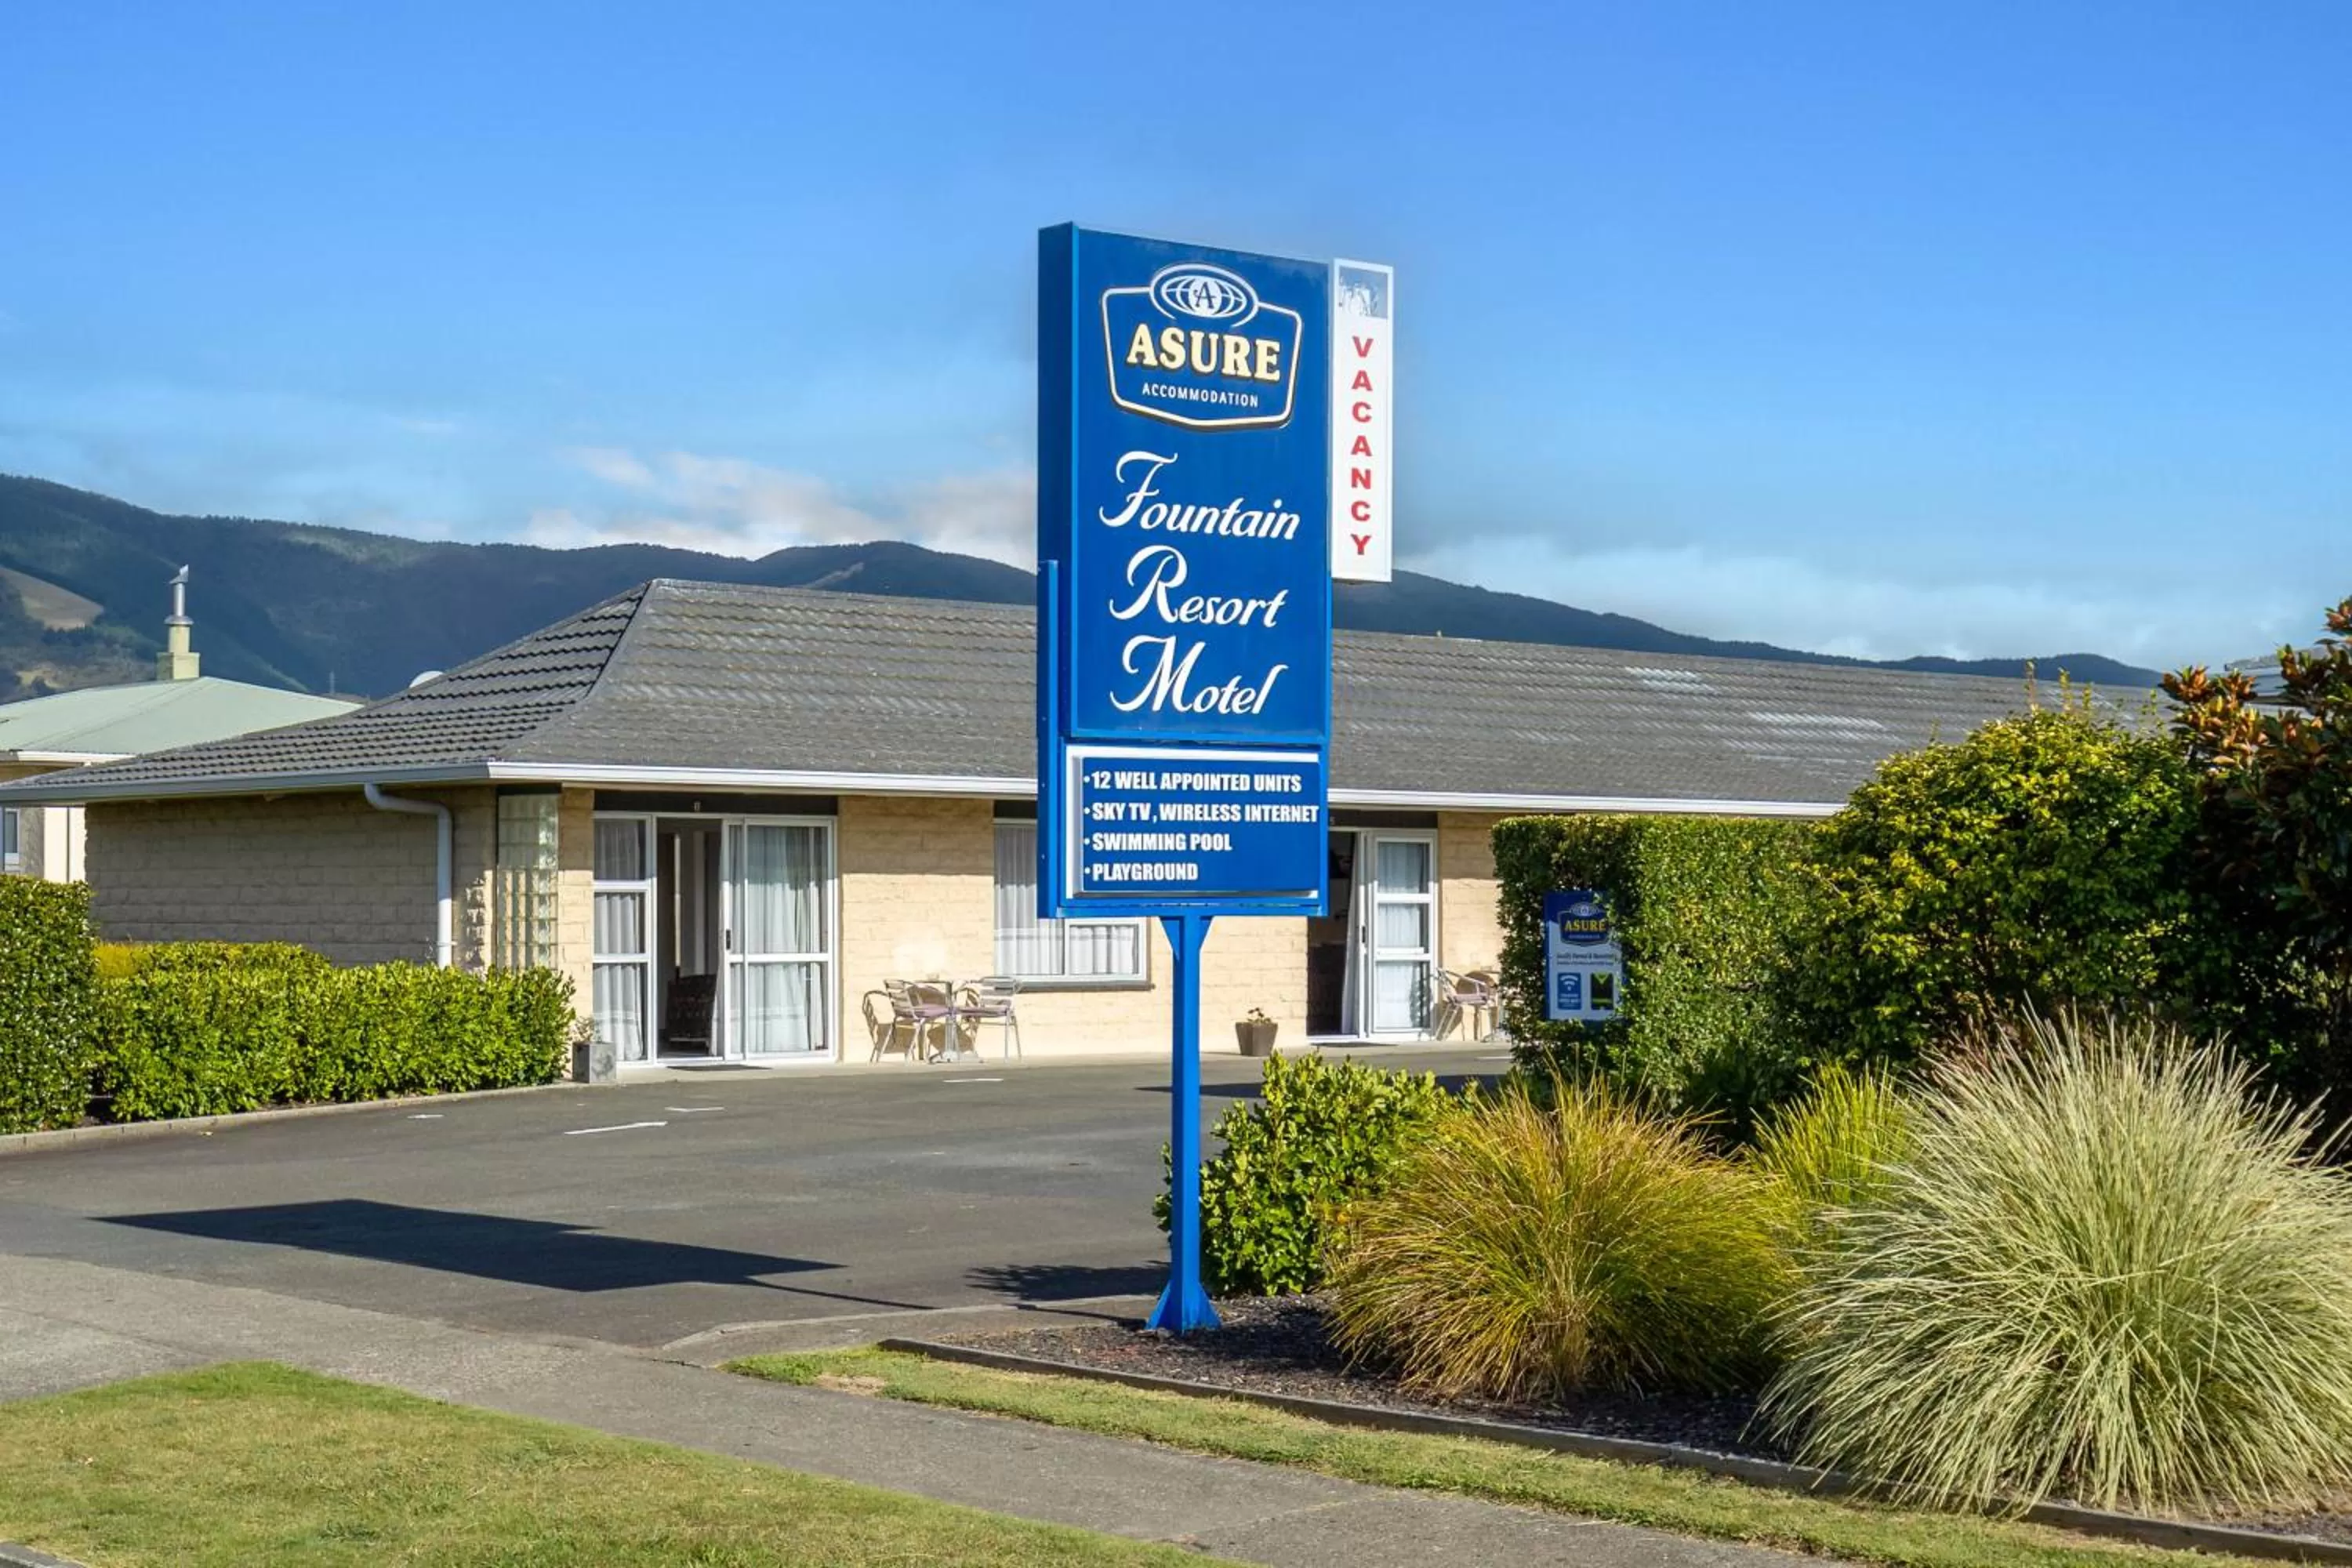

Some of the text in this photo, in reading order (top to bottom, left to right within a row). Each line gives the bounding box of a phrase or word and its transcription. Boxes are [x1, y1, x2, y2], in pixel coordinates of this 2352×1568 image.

[1127, 323, 1281, 382] ASURE
[1142, 383, 1258, 408] ACCOMMODATION
[1351, 336, 1374, 556] VACANCY
[1099, 451, 1300, 539] Fountain
[1109, 545, 1289, 627] Resort
[1109, 635, 1289, 714] Motel
[1091, 771, 1302, 793] 12 WELL APPOINTED UNITS
[1092, 803, 1126, 821] SKY
[1160, 804, 1242, 822] WIRELESS
[1245, 805, 1319, 823] INTERNET
[1092, 833, 1232, 851] SWIMMING POOL
[1092, 863, 1199, 881] PLAYGROUND
[1565, 919, 1606, 932] ASURE
